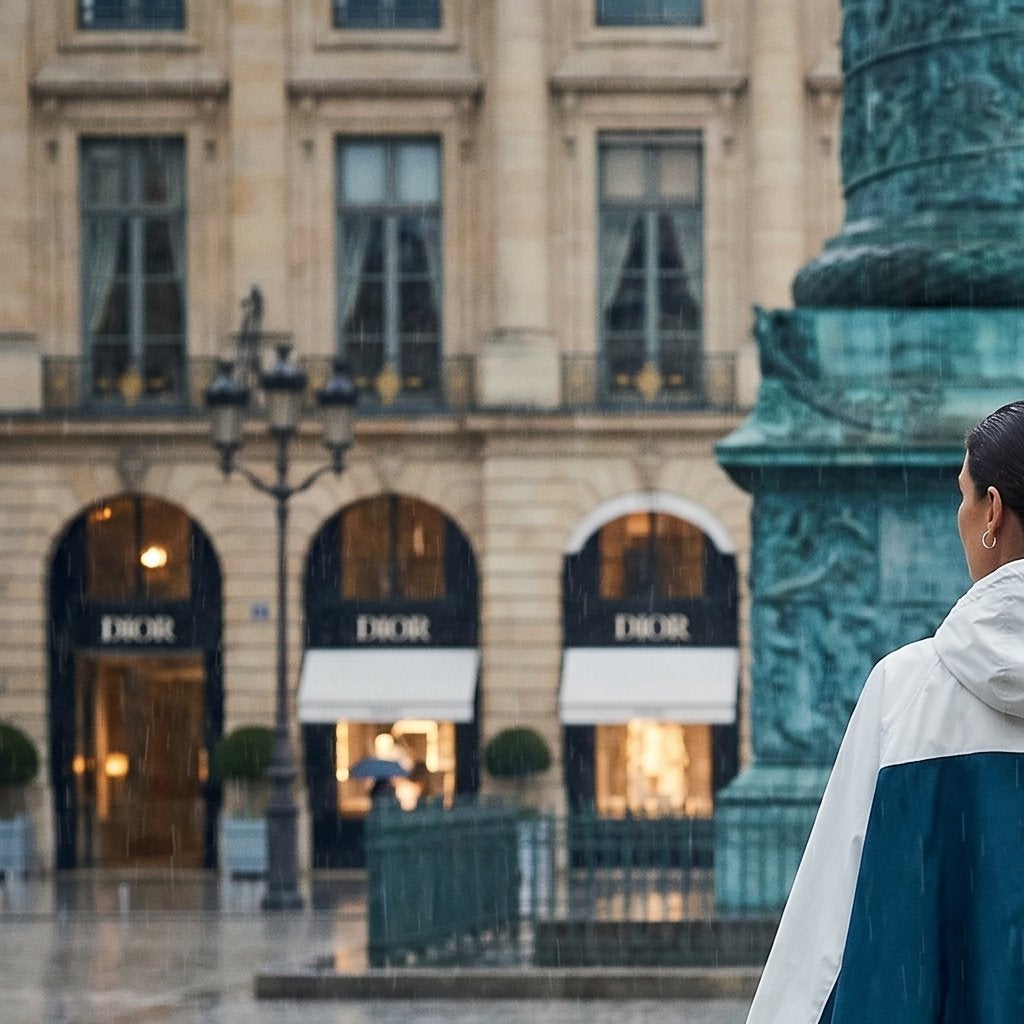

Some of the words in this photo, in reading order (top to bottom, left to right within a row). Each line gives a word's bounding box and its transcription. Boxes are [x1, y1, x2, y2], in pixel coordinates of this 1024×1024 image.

[101, 614, 175, 643] DIOR
[356, 613, 431, 643] DIOR
[614, 612, 690, 642] DIOR
